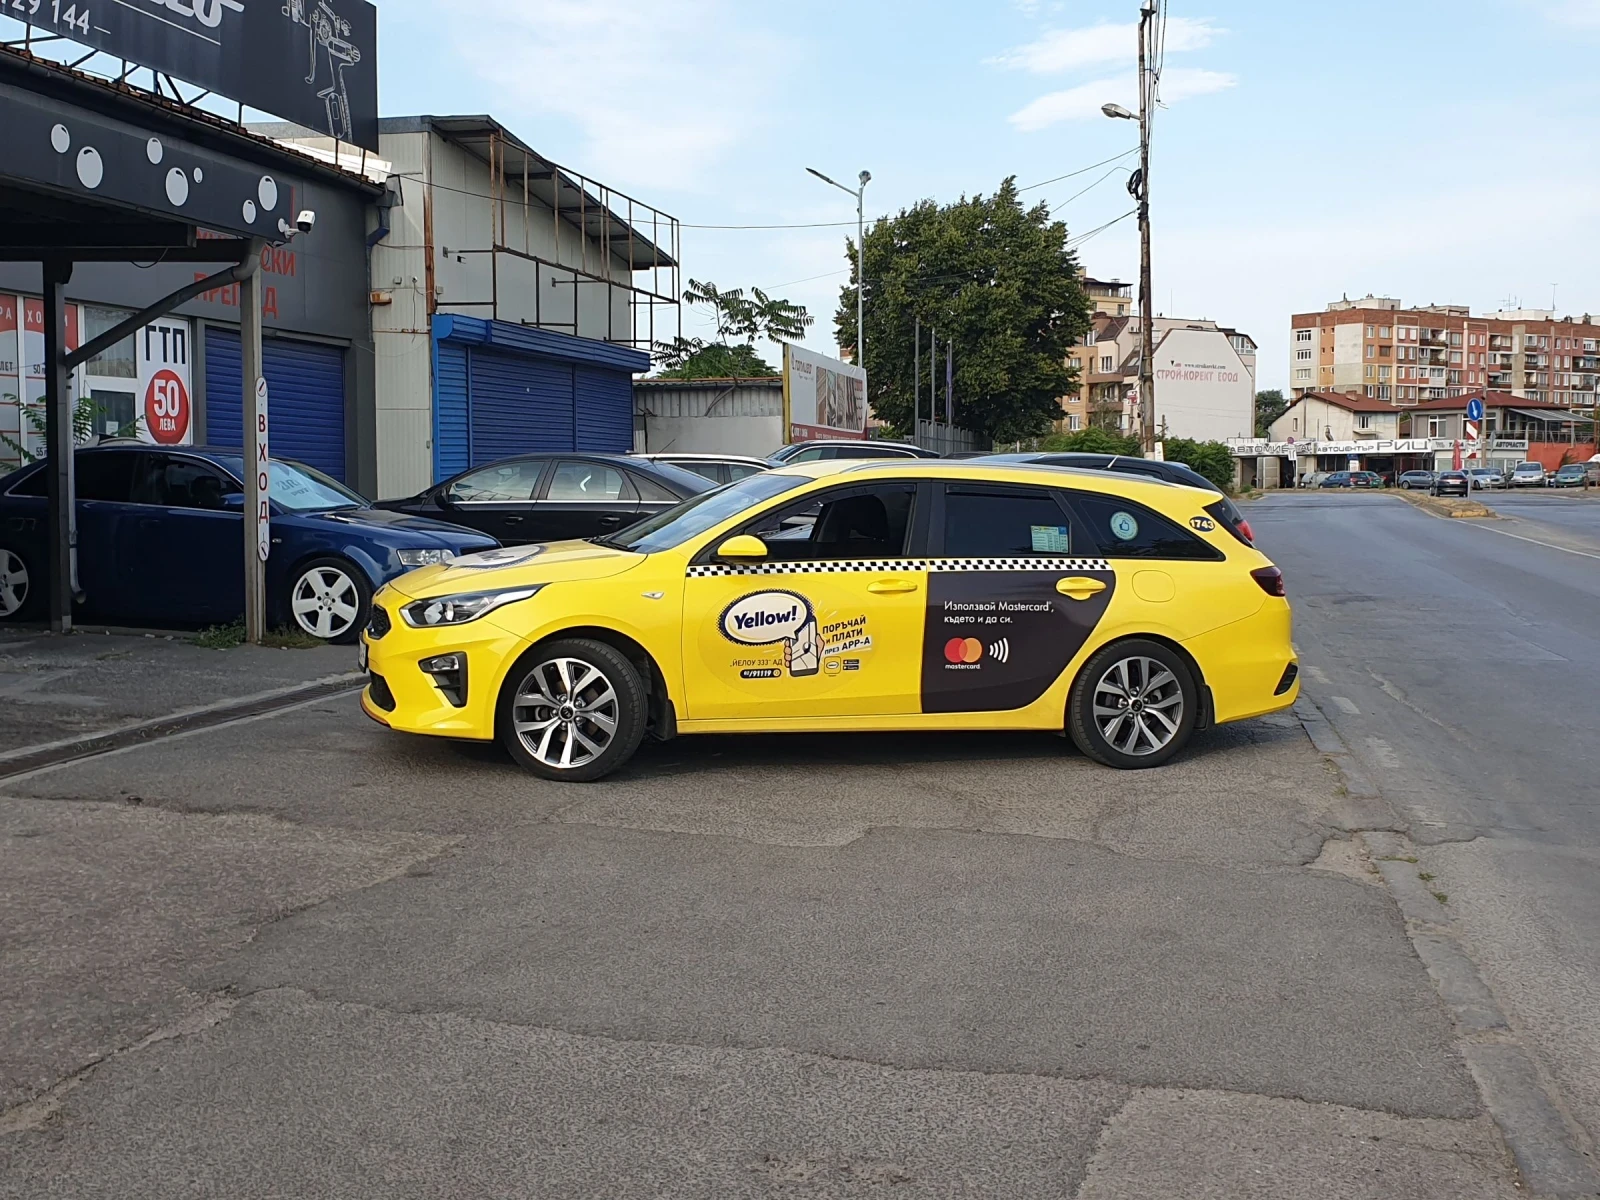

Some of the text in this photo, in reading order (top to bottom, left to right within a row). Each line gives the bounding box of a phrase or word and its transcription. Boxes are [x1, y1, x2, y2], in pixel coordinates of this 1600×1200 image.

[145, 325, 186, 364] ГТП
[153, 378, 180, 417] 50
[159, 418, 176, 431] ЛЕВА
[1377, 440, 1429, 451] РИЦ
[258, 413, 268, 524] ВХОД
[1189, 518, 1215, 530] 1743
[944, 600, 996, 611] Използвай
[734, 605, 798, 630] Yellow!
[822, 614, 866, 635] ПОРЪЧАЙ
[944, 615, 975, 625] където
[985, 616, 998, 625] да
[999, 616, 1013, 624] си.
[832, 628, 863, 643] ПЛАТИ
